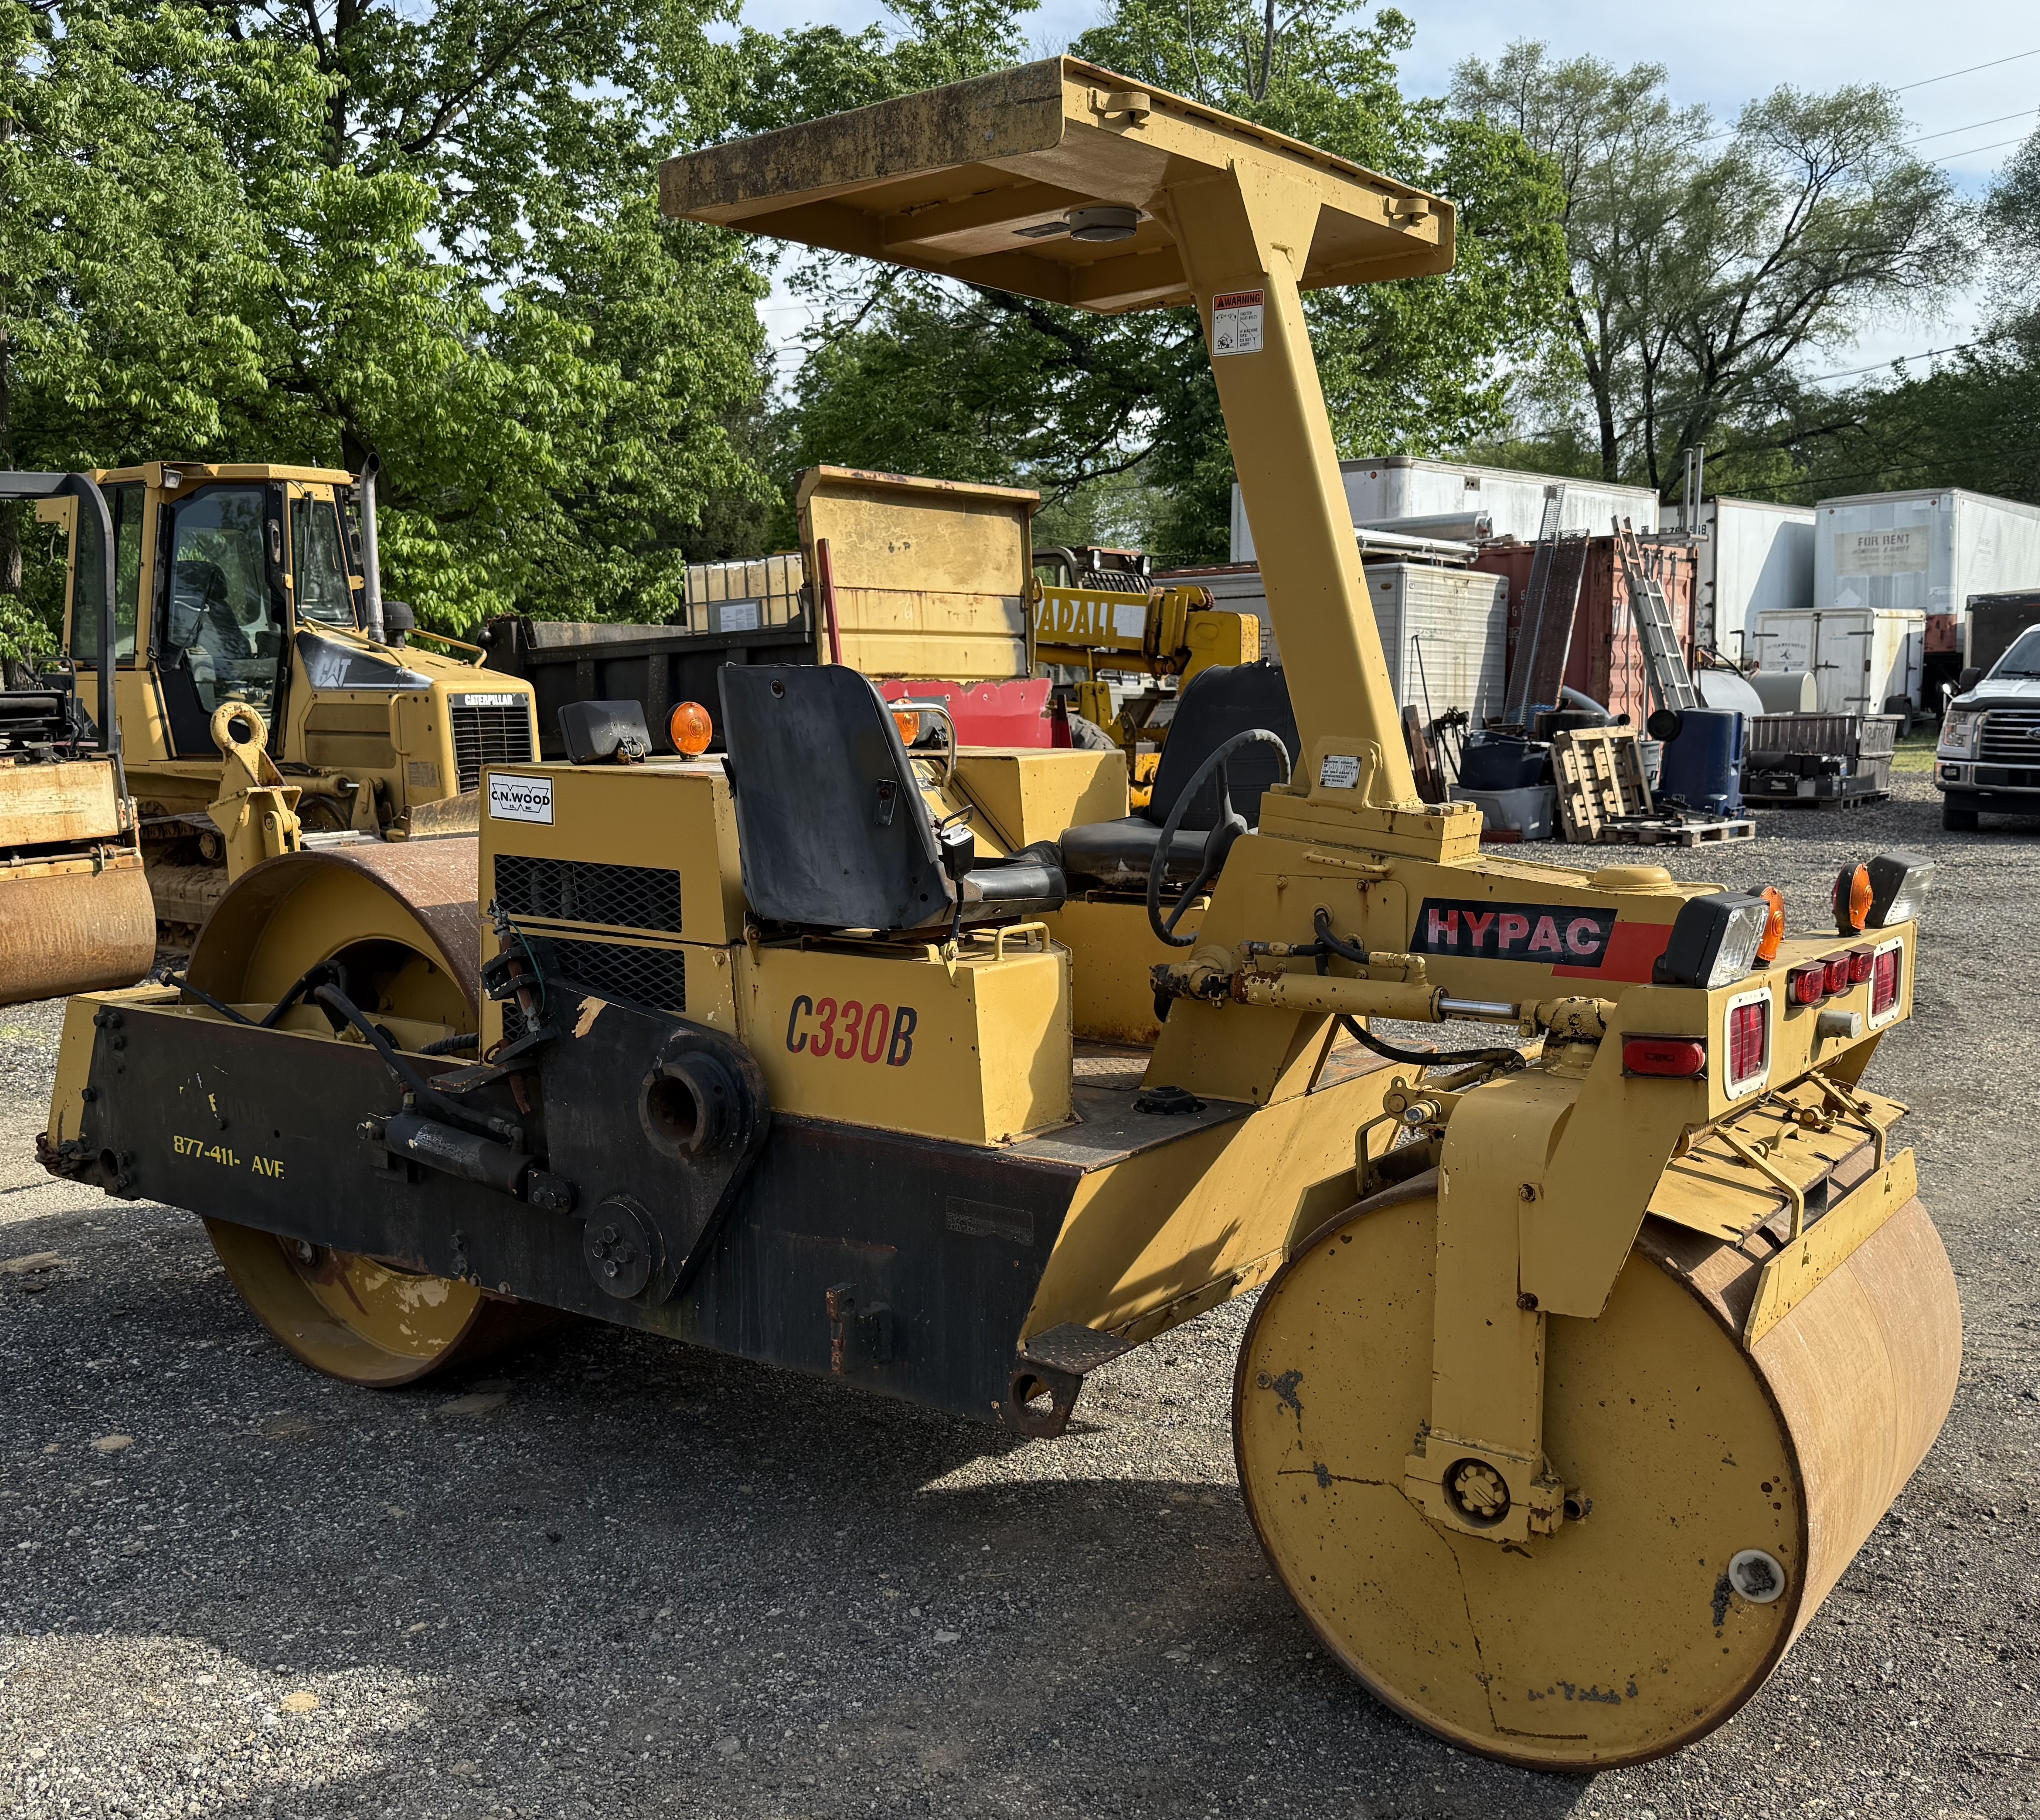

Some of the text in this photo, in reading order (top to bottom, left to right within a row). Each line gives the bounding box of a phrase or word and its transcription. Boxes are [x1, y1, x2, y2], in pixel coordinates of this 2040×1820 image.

[1224, 294, 1260, 306] WARNING
[1858, 534, 1909, 547] FOR RENT
[1035, 599, 1117, 636] ADALL
[314, 659, 352, 687] CAT
[465, 694, 513, 705] CATERPILLAR
[1428, 908, 1601, 955] HYPAC
[786, 995, 918, 1067] C330B
